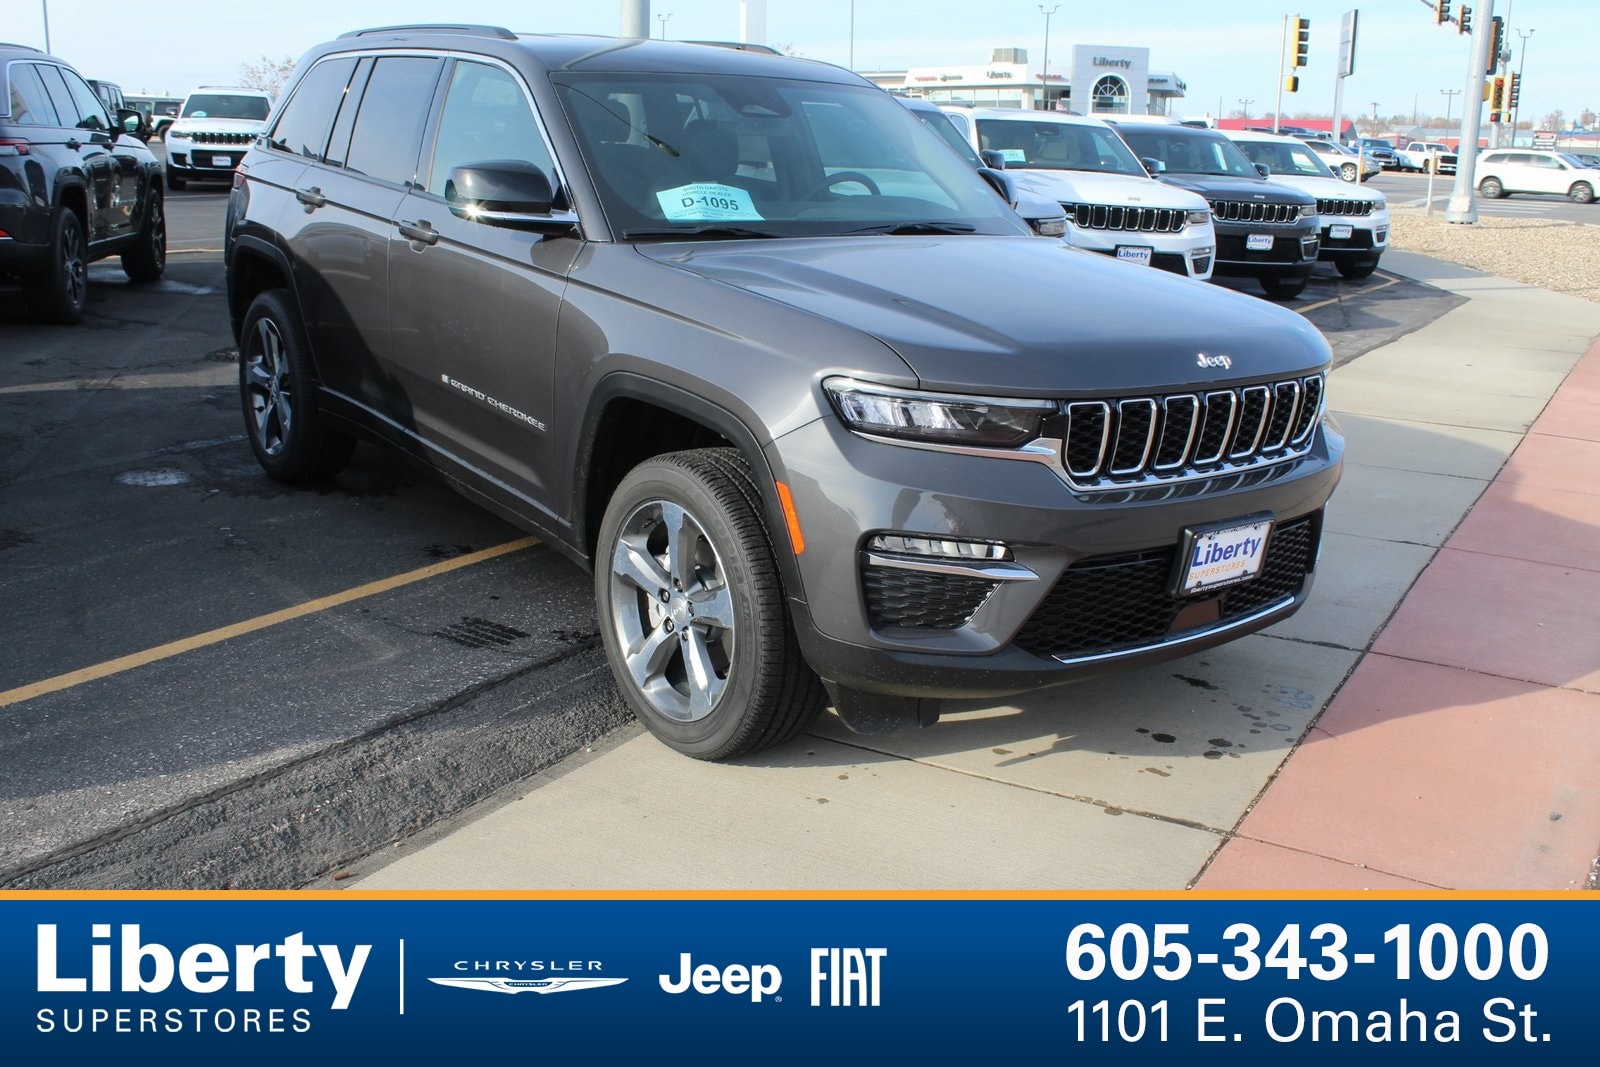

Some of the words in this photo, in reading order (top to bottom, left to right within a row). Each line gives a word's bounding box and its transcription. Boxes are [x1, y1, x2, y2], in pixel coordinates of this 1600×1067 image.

[1093, 56, 1131, 70] Liberty
[681, 196, 739, 211] D-1095
[1118, 250, 1149, 260] Liberty
[1197, 353, 1232, 370] Jeep
[450, 379, 485, 400] GRAND
[487, 396, 546, 432] CHEROKEE
[1192, 538, 1261, 567] Liberty
[1190, 560, 1246, 580] SUPERSTORES
